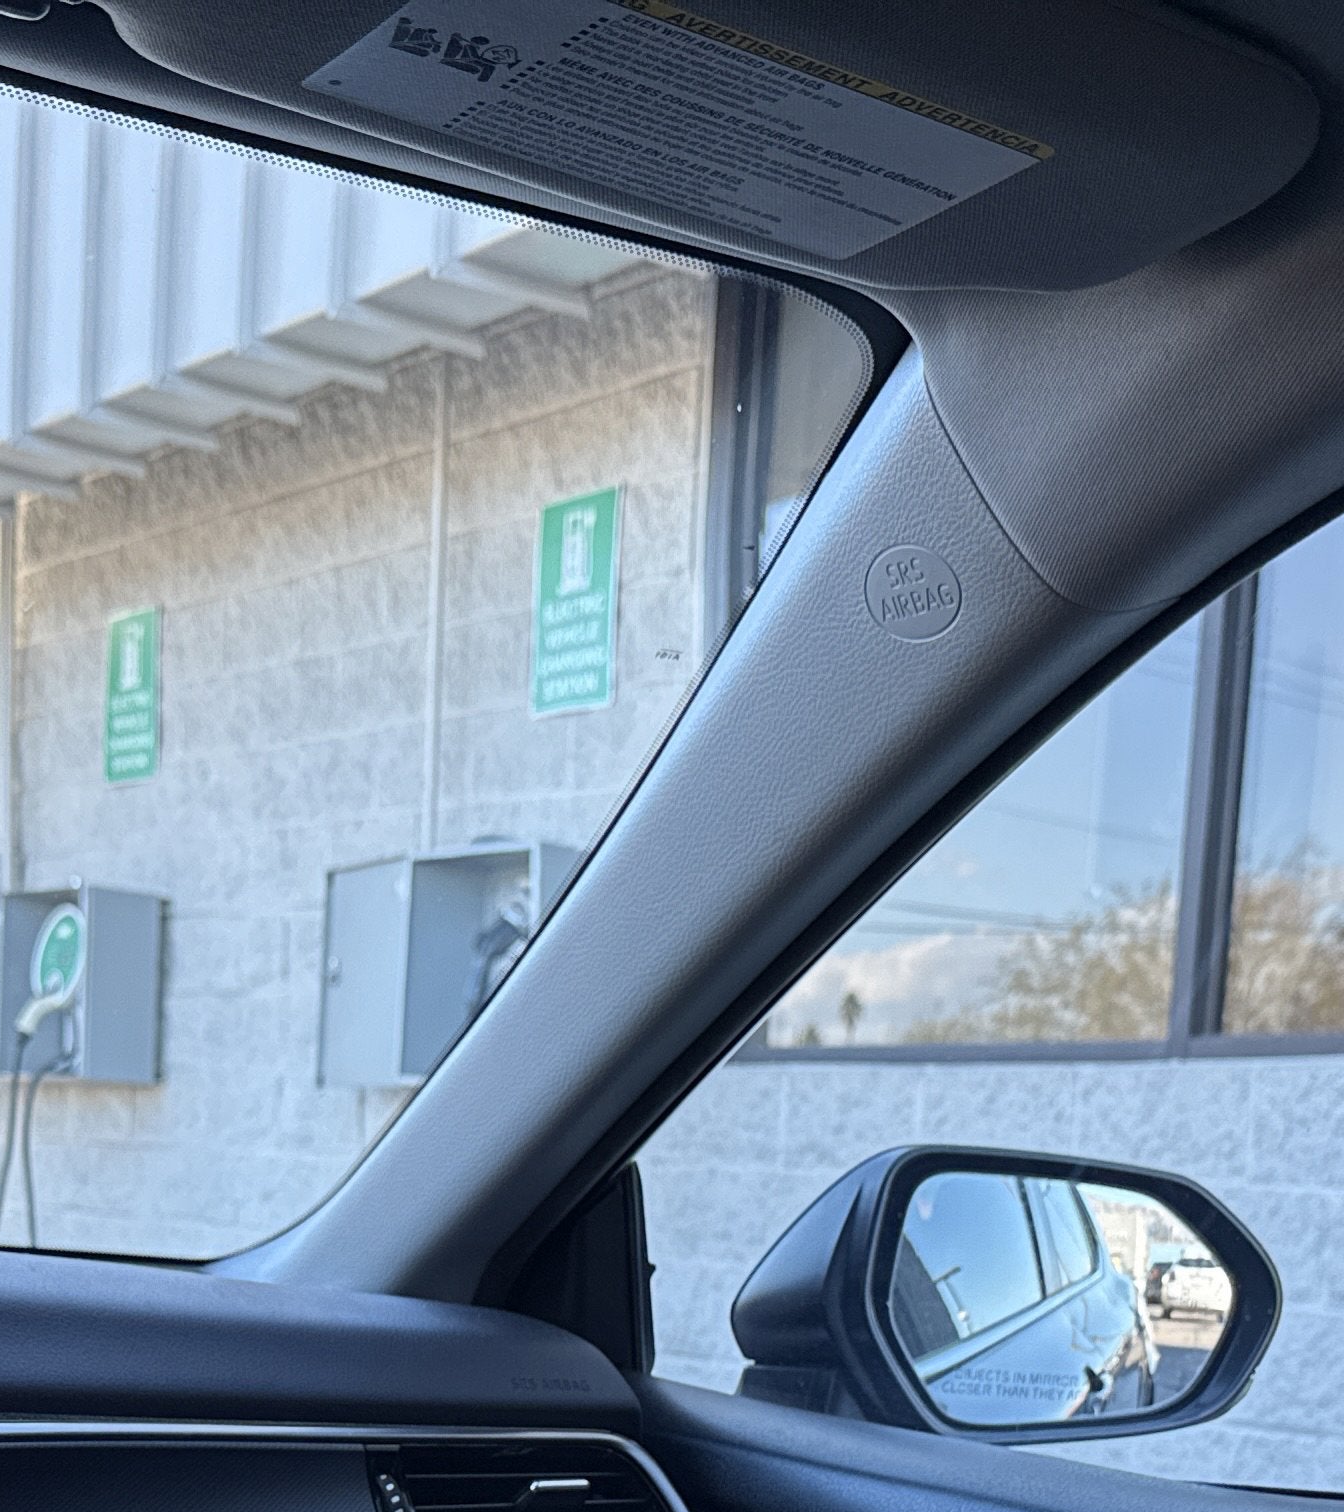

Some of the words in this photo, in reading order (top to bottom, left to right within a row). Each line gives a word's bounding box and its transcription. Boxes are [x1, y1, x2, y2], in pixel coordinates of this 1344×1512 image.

[620, 13, 662, 31] EVEN
[658, 27, 698, 44] WITH
[692, 39, 767, 69] ADVANCED
[761, 64, 790, 78] AIR
[785, 72, 827, 91] BAGS
[665, 12, 873, 91] AVERTISSEMENT
[877, 90, 1041, 154] ADVERTENCIA
[595, 70, 637, 88] AVEC
[631, 82, 664, 98] DES
[658, 92, 728, 120] COUSSINS
[721, 114, 747, 127] DE
[799, 141, 825, 154] DE
[524, 107, 560, 122] CON
[573, 123, 645, 152] AVANZADO
[657, 152, 690, 168] LOS
[683, 162, 712, 175] AIR
[885, 556, 926, 590] SRS
[882, 582, 955, 622] AIRBAG
[941, 1380, 991, 1397] CLOSER
[995, 1385, 1029, 1399] THAN
[1032, 1386, 1065, 1400] THEY
[1013, 1372, 1025, 1384] IN
[1029, 1373, 1079, 1387] MIRROR
